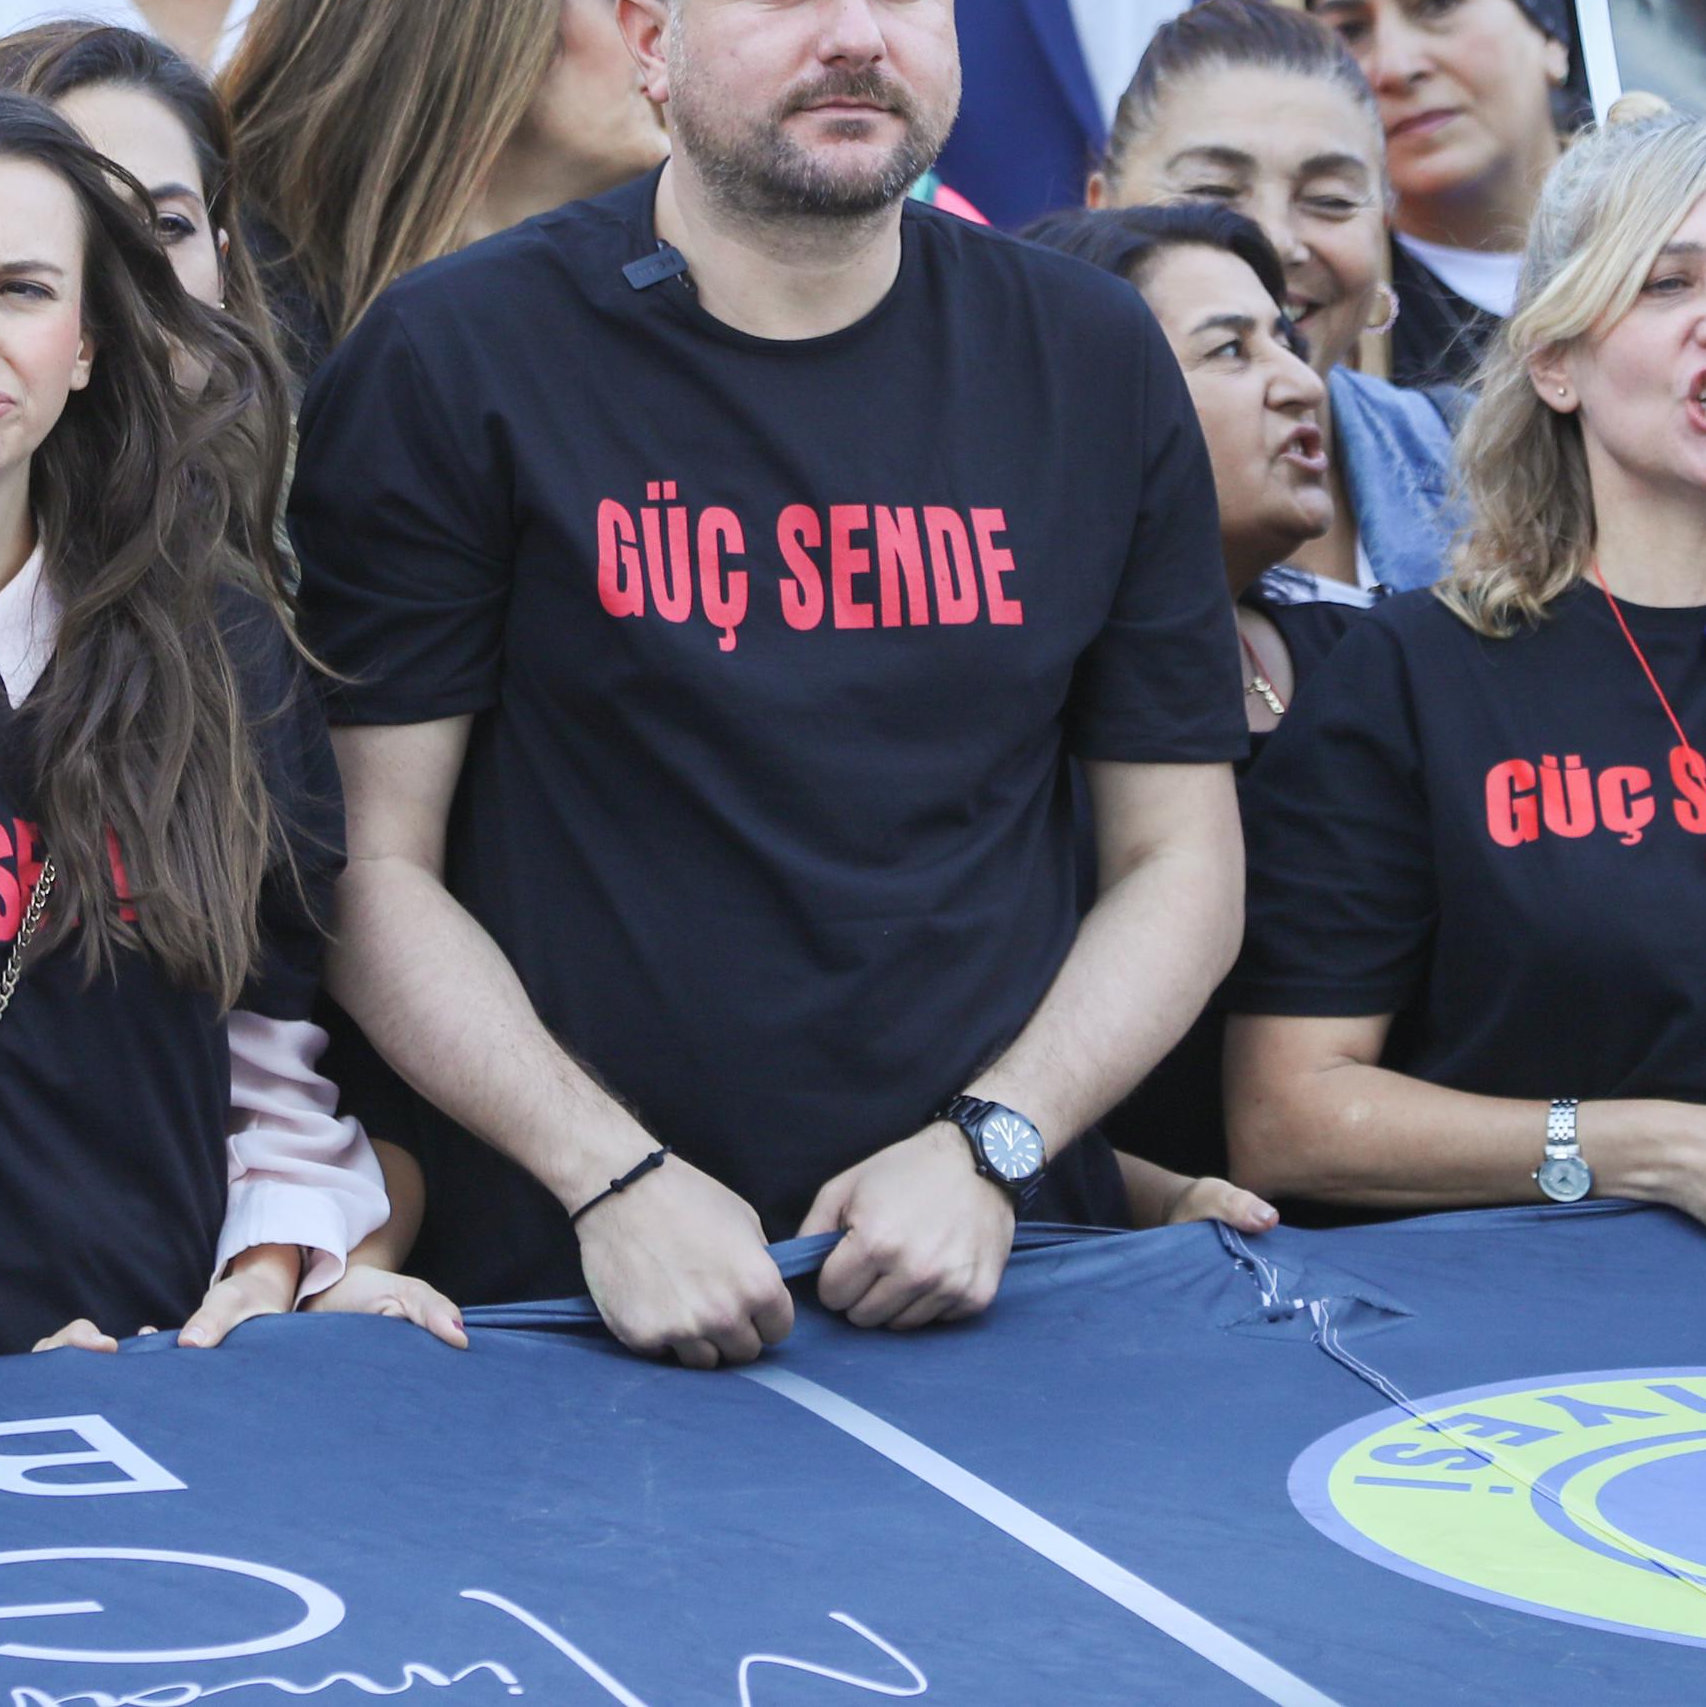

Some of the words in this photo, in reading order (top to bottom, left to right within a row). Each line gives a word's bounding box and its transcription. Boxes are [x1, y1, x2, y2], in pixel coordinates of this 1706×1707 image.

[596, 480, 749, 652] GÜÇ
[775, 504, 1024, 631] SENDE
[1485, 754, 1656, 848] GÜÇ
